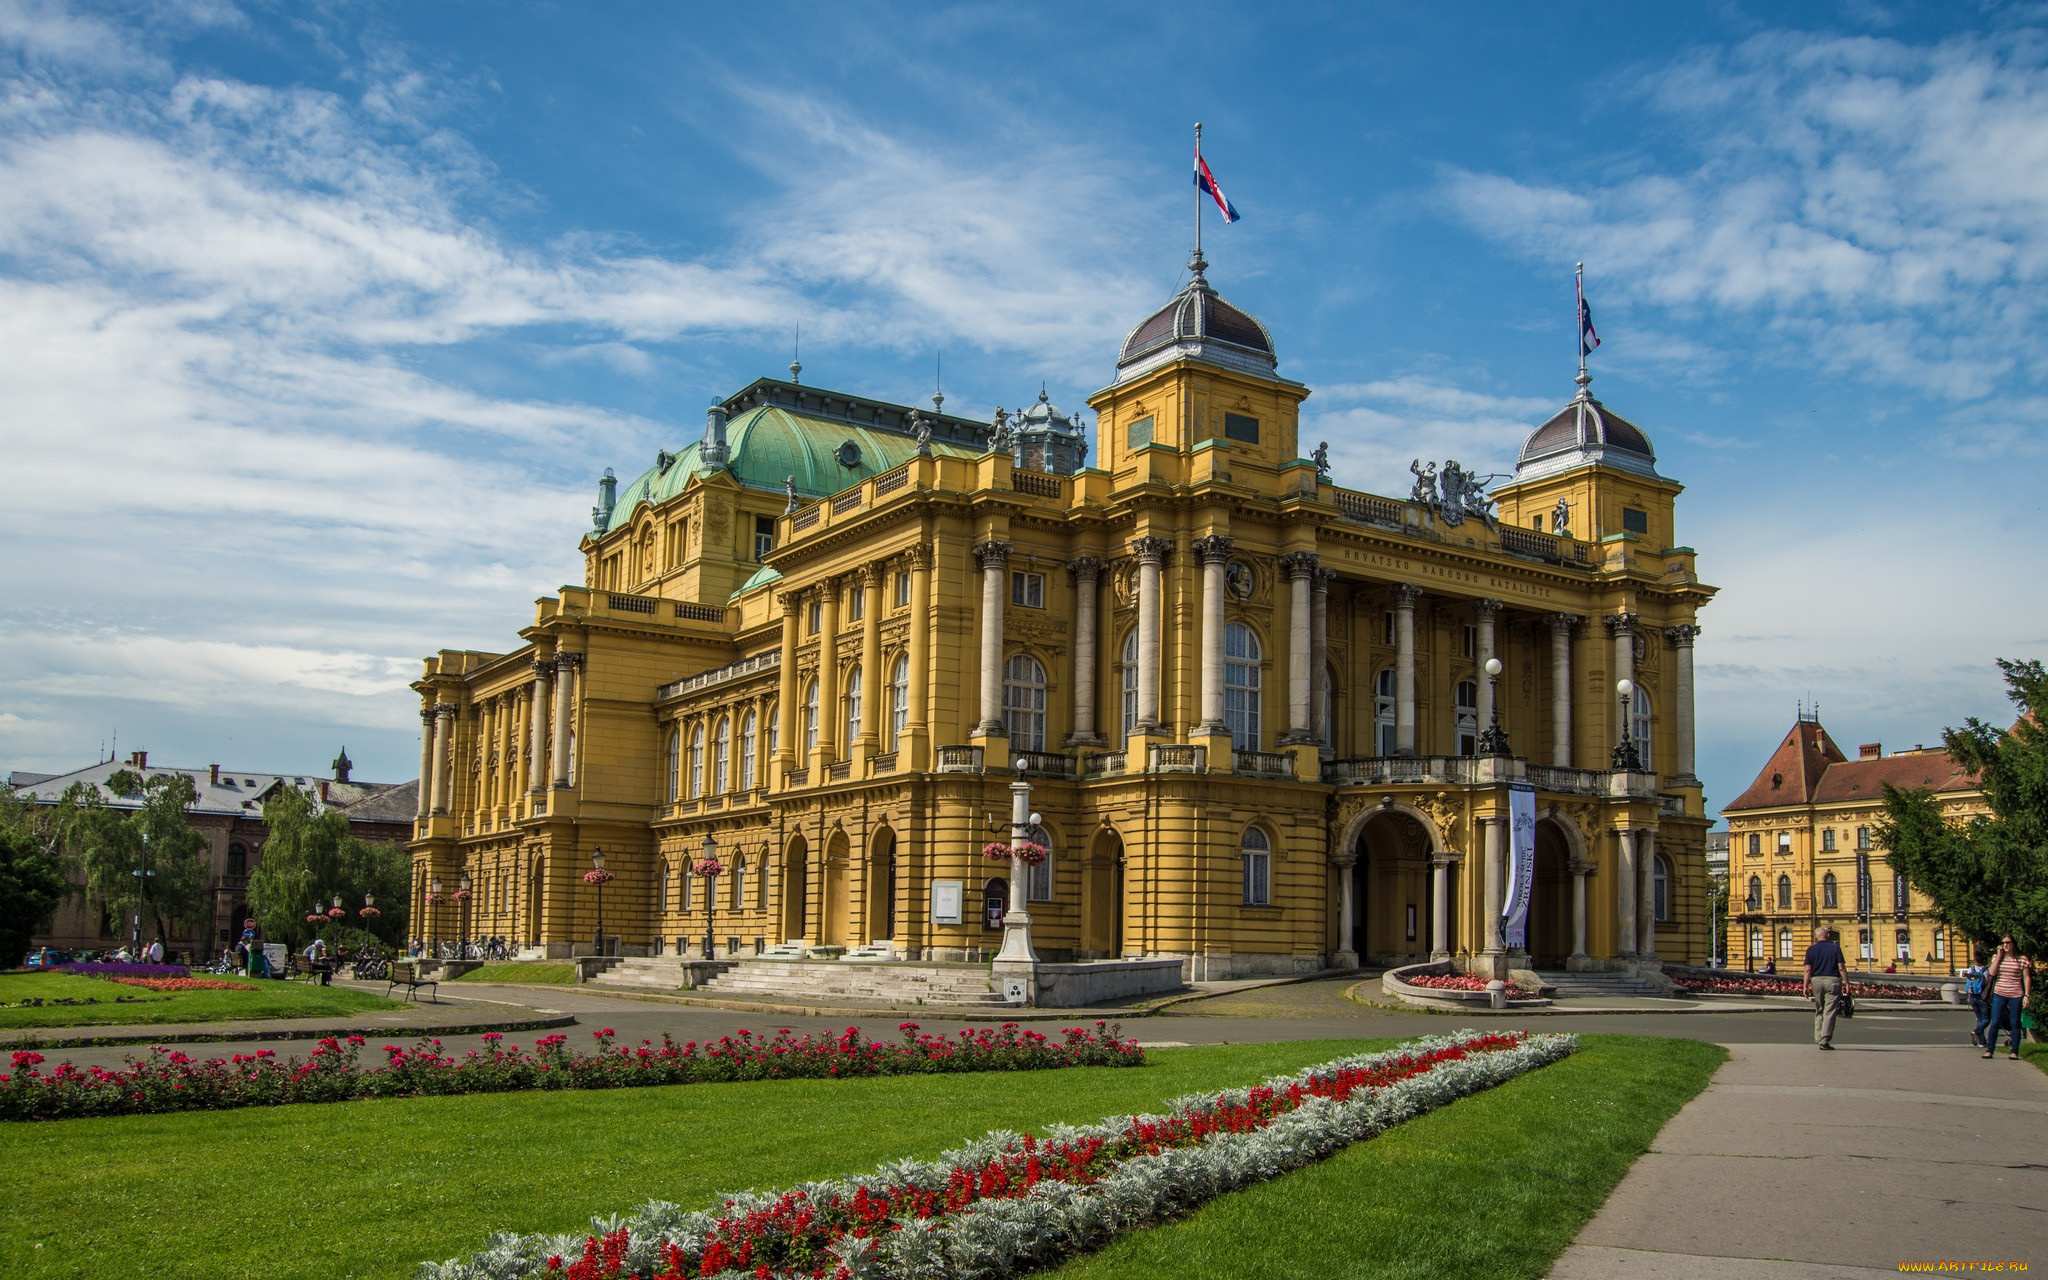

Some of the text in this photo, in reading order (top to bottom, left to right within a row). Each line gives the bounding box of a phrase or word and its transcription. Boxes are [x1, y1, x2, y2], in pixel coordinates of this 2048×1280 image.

[1344, 549, 1550, 598] HRVATSKO NARODNO KAZALIŠTE
[1516, 874, 1525, 908] NIKOLA
[1521, 846, 1533, 908] ZRINJSKI
